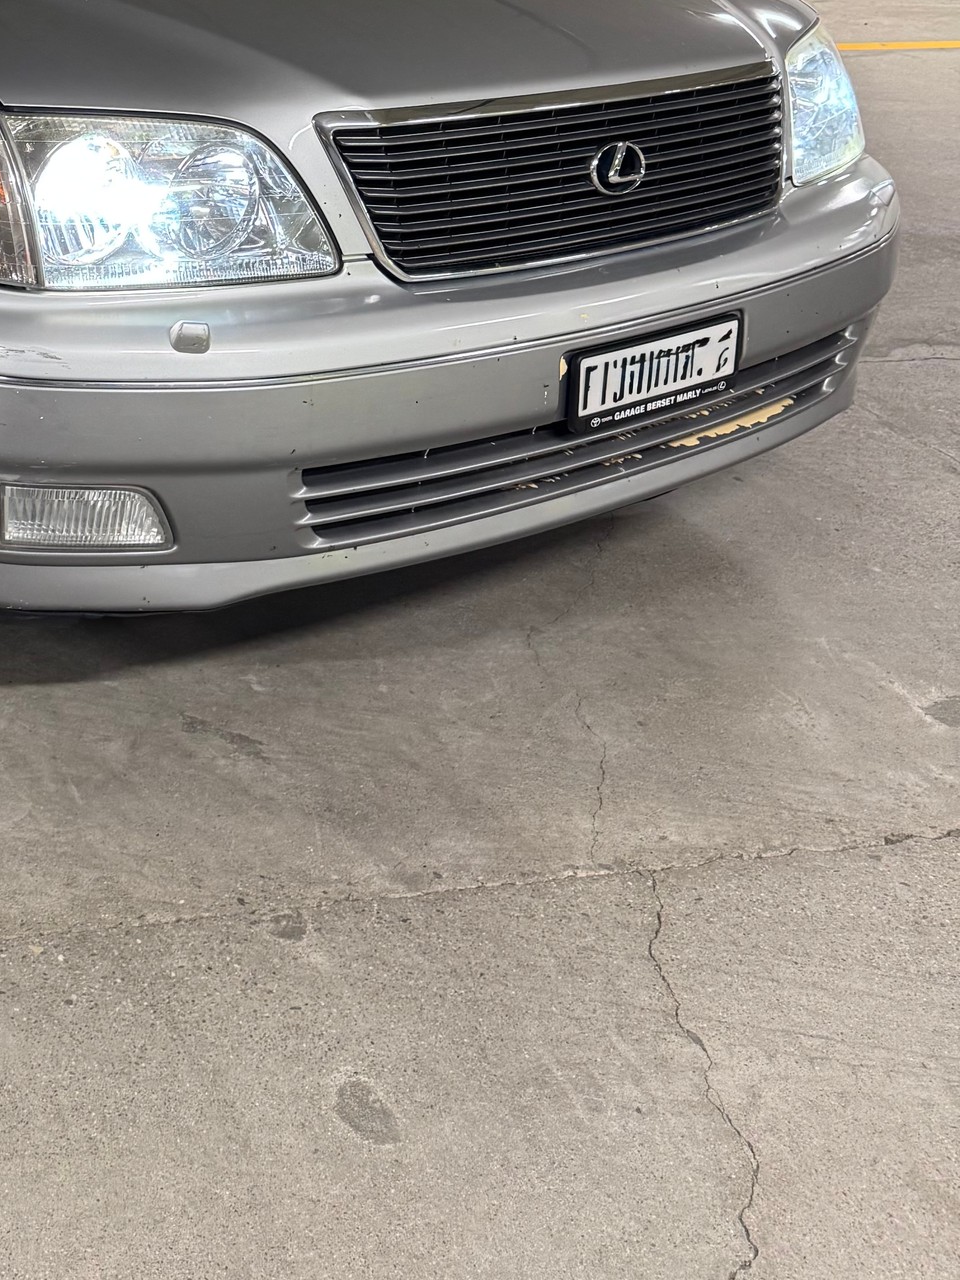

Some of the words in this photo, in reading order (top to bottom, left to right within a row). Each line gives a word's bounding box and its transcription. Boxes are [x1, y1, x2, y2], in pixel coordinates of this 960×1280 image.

[613, 403, 646, 421] GARAGE
[646, 396, 676, 412] BERSET
[676, 388, 702, 403] MARLY
